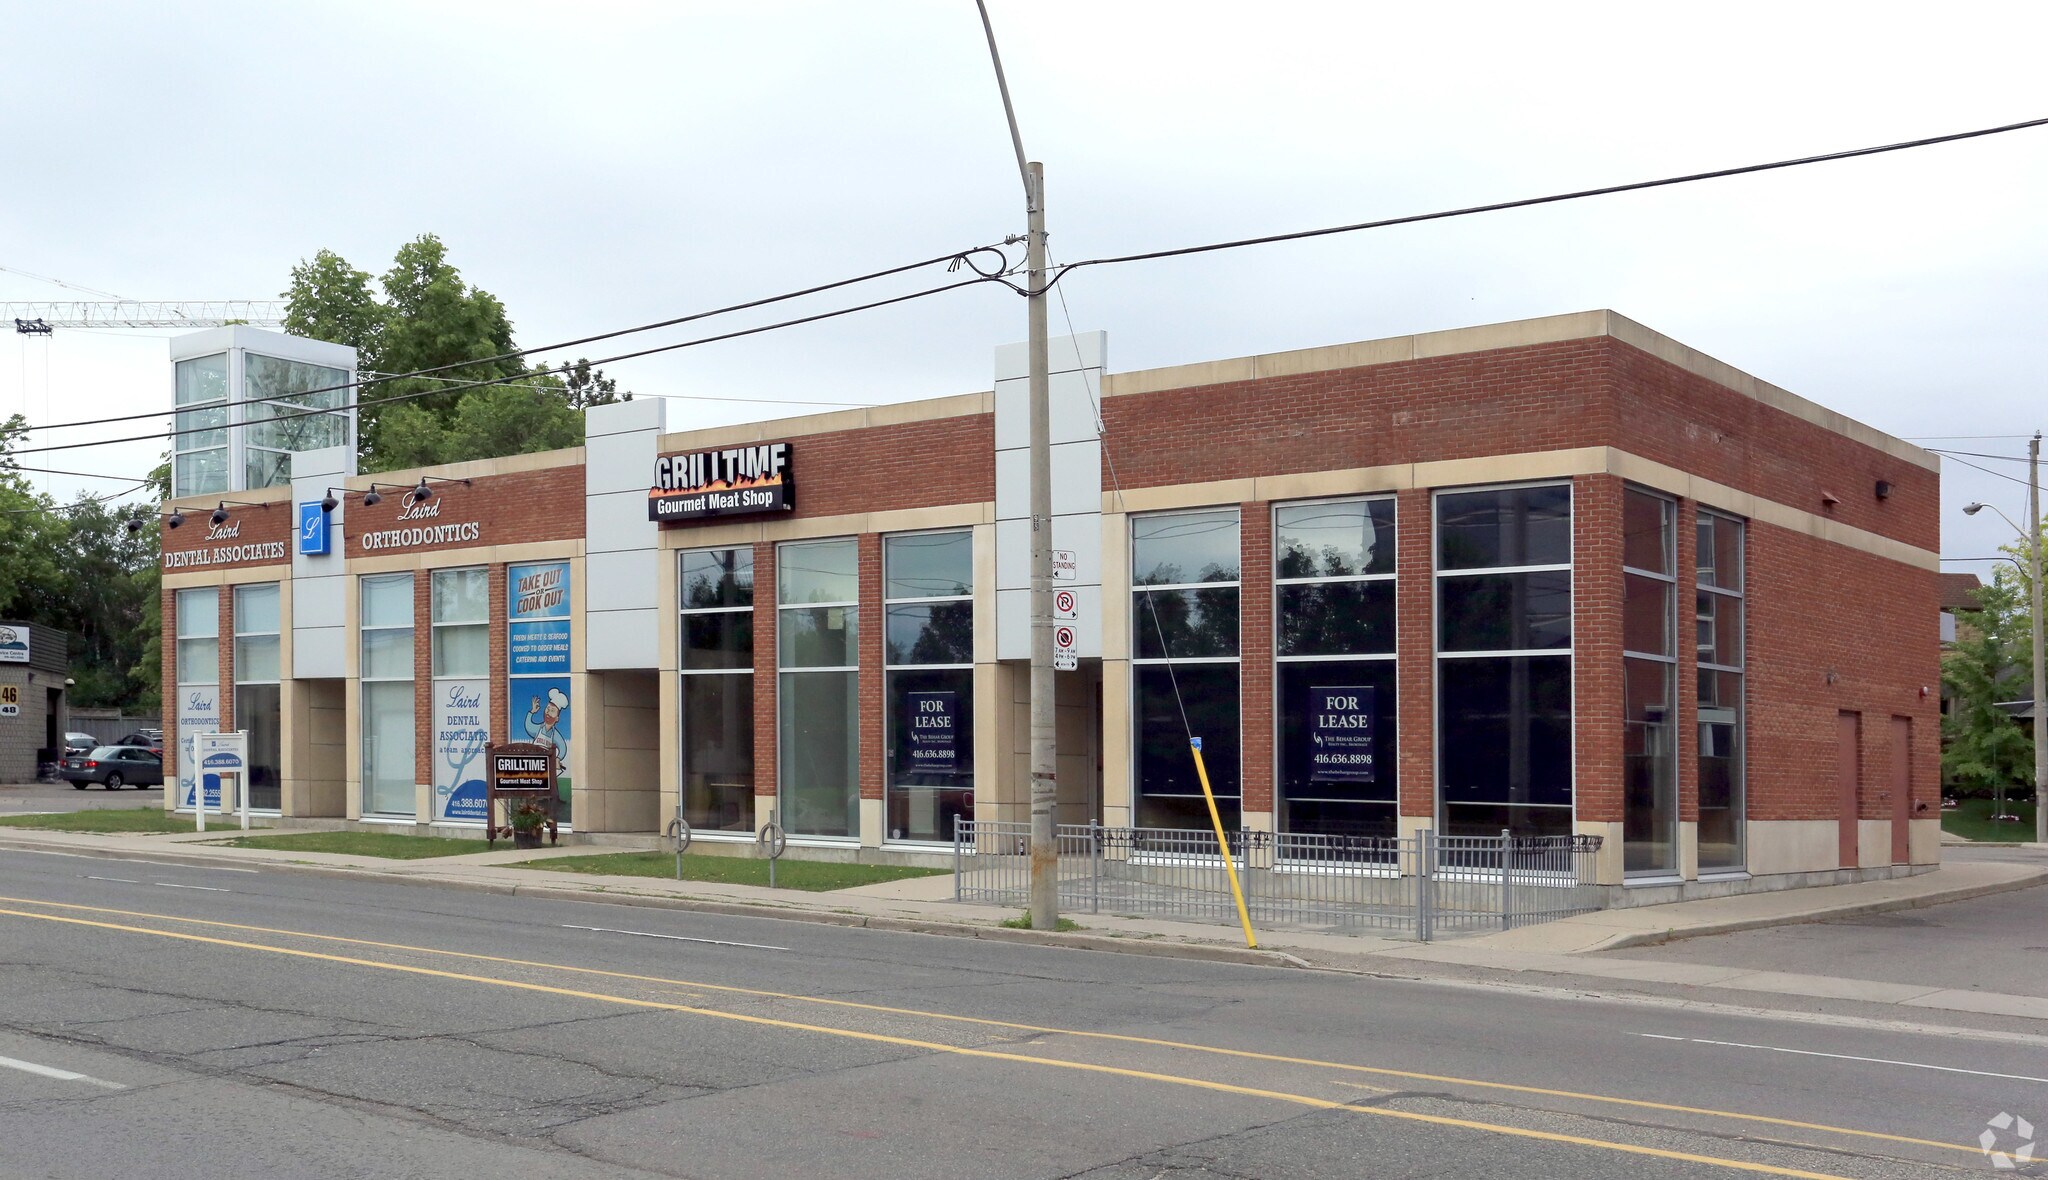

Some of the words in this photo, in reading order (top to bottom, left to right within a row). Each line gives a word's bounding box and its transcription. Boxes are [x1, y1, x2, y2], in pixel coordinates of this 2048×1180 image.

[397, 492, 441, 521] Laird
[657, 495, 706, 514] Gourmet
[708, 493, 740, 510] Meat
[742, 490, 773, 507] Shop
[205, 517, 241, 540] Laird
[362, 522, 480, 550] ORTHODONTICS
[165, 549, 211, 568] DENTAL
[212, 542, 285, 564] ASSOCIATES
[518, 574, 541, 592] TAKE
[542, 568, 562, 587] OUT
[536, 588, 544, 596] OR
[517, 595, 542, 614] COOK
[544, 590, 564, 608] OUT
[2, 688, 17, 702] 46
[188, 692, 212, 710] Laird
[446, 686, 480, 708] Laird
[920, 701, 944, 712] FOR
[1326, 696, 1360, 710] FOR
[181, 717, 220, 725] ORTHODONTICS
[447, 716, 480, 725] DENTAL
[915, 716, 951, 728] LEASE
[1319, 715, 1368, 728] LEASE
[440, 731, 488, 741] ASSOCIATES
[912, 750, 955, 758] 416.636.8898
[1314, 754, 1372, 764] 416.636.8898
[498, 759, 546, 771] GRILLTIME
